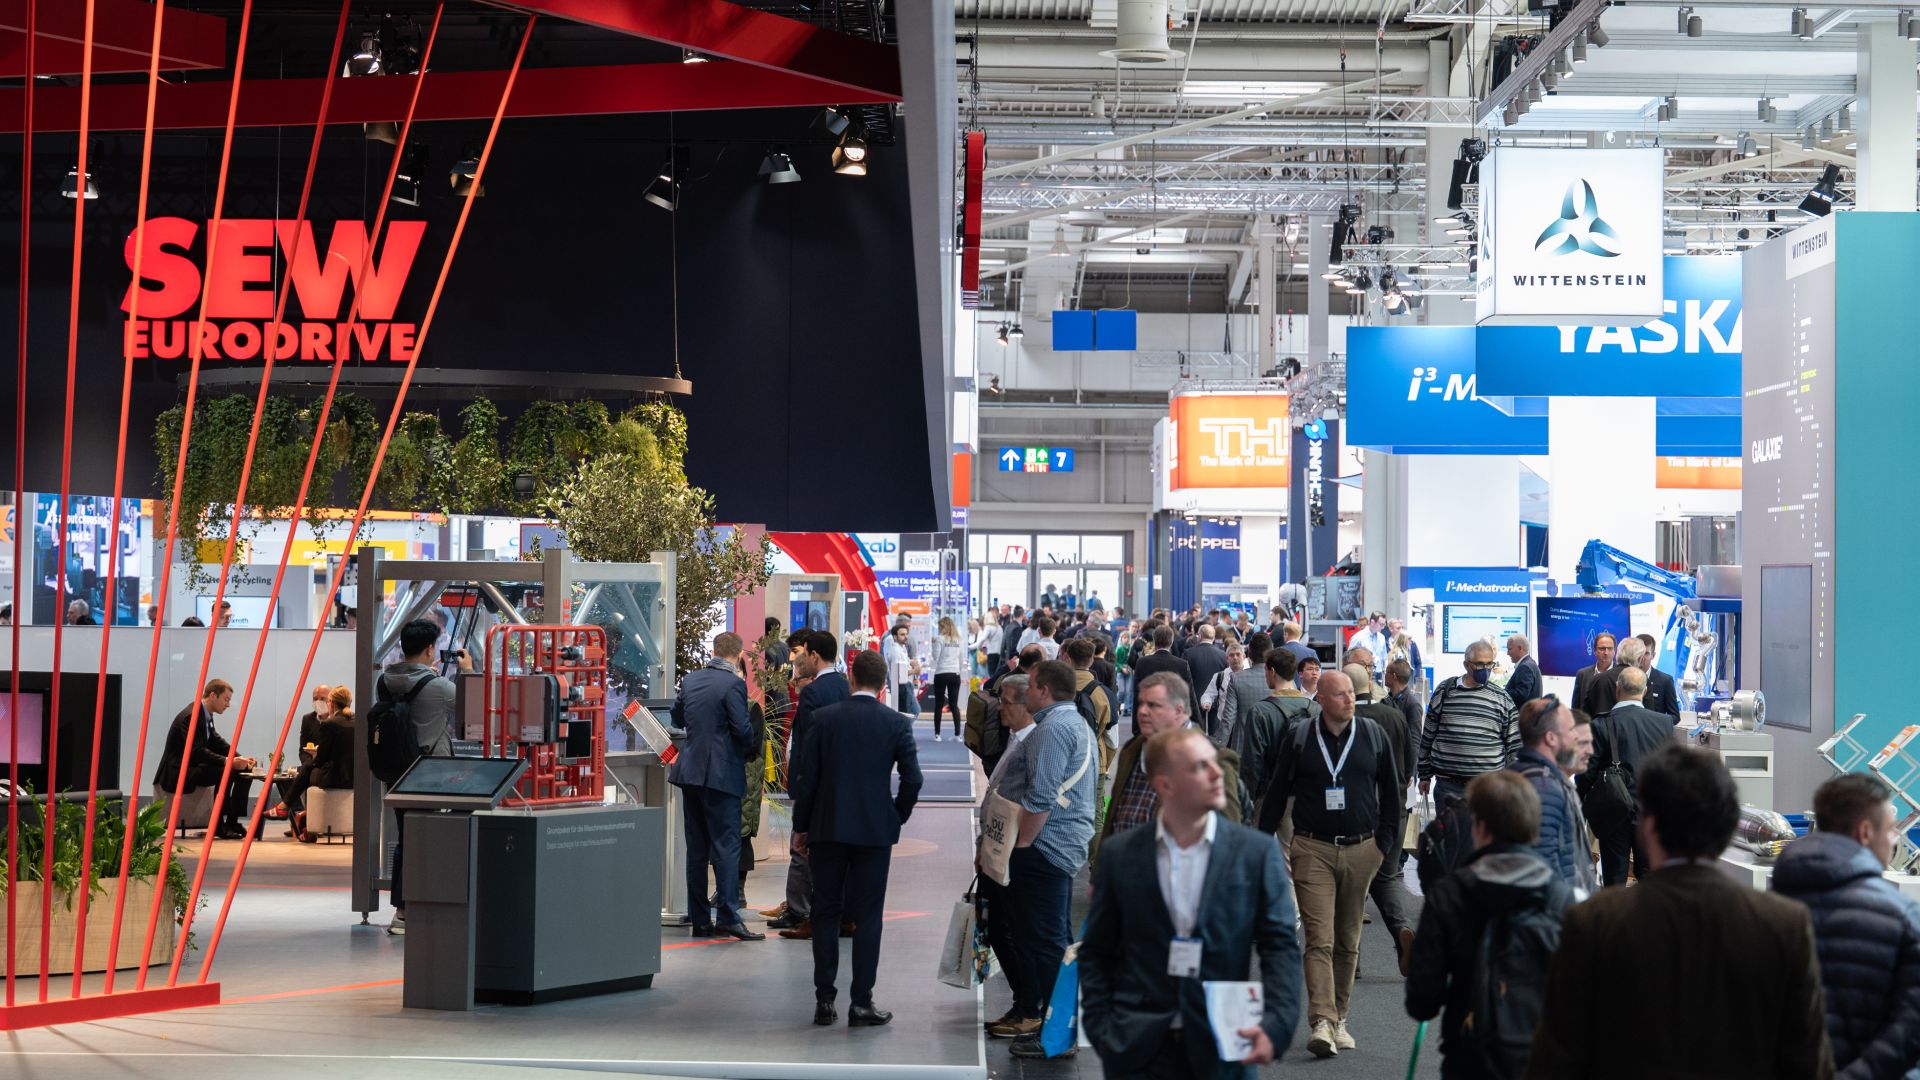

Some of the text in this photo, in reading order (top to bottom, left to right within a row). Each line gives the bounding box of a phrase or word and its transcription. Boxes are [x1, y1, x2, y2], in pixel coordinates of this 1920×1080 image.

[120, 216, 427, 320] SEW
[1513, 275, 1646, 286] WITTENSTEIN
[124, 320, 421, 361] EURODRIVE
[1056, 452, 1067, 467] 7
